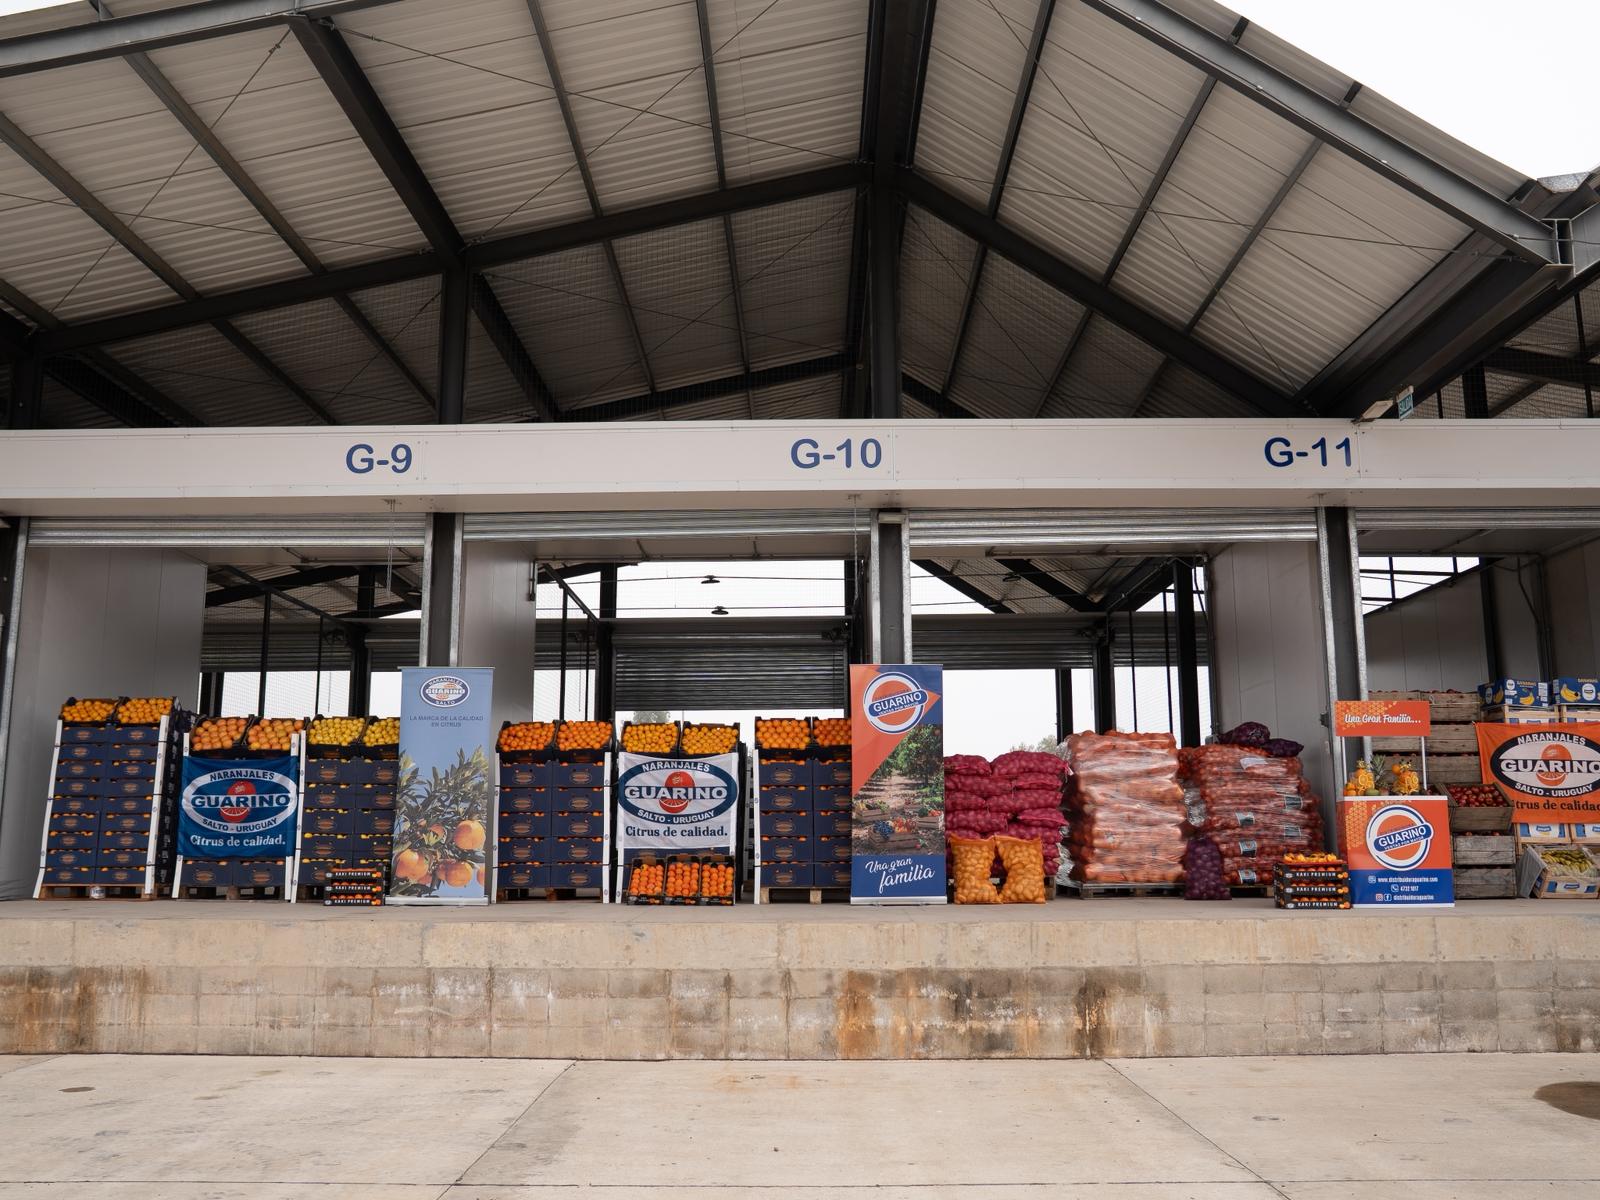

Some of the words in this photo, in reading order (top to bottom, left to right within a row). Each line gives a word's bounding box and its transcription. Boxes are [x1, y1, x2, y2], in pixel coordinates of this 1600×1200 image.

[346, 444, 412, 473] G-9
[790, 438, 881, 468] G-10
[1264, 437, 1352, 467] G-11
[873, 691, 922, 712] GUARINO
[1344, 714, 1361, 723] Una
[1362, 713, 1381, 723] Gran
[1517, 733, 1586, 746] NARANJALES
[642, 761, 710, 772] NARANJALES
[1500, 759, 1600, 773] GUARINO
[209, 770, 275, 781] NARANJALES
[624, 786, 728, 799] GUARINO
[1515, 783, 1544, 795] SALTO
[1551, 784, 1593, 797] URUGUAY
[190, 795, 291, 808] GUARINO
[1512, 800, 1540, 810] trus
[1543, 800, 1557, 810] de
[637, 809, 666, 822] SALTO
[673, 810, 715, 824] URUGUAY
[202, 819, 229, 832] SALTO
[236, 818, 277, 832] URUGUAY
[625, 826, 660, 837] Citrus
[663, 826, 677, 836] de
[680, 826, 728, 836] calidad.
[190, 834, 224, 846] Citrus
[227, 836, 240, 846] de
[243, 834, 286, 846] calidad.
[1378, 826, 1427, 847] GUARINO
[865, 861, 889, 873] Una
[888, 857, 913, 873] gran
[879, 864, 935, 894] familia
